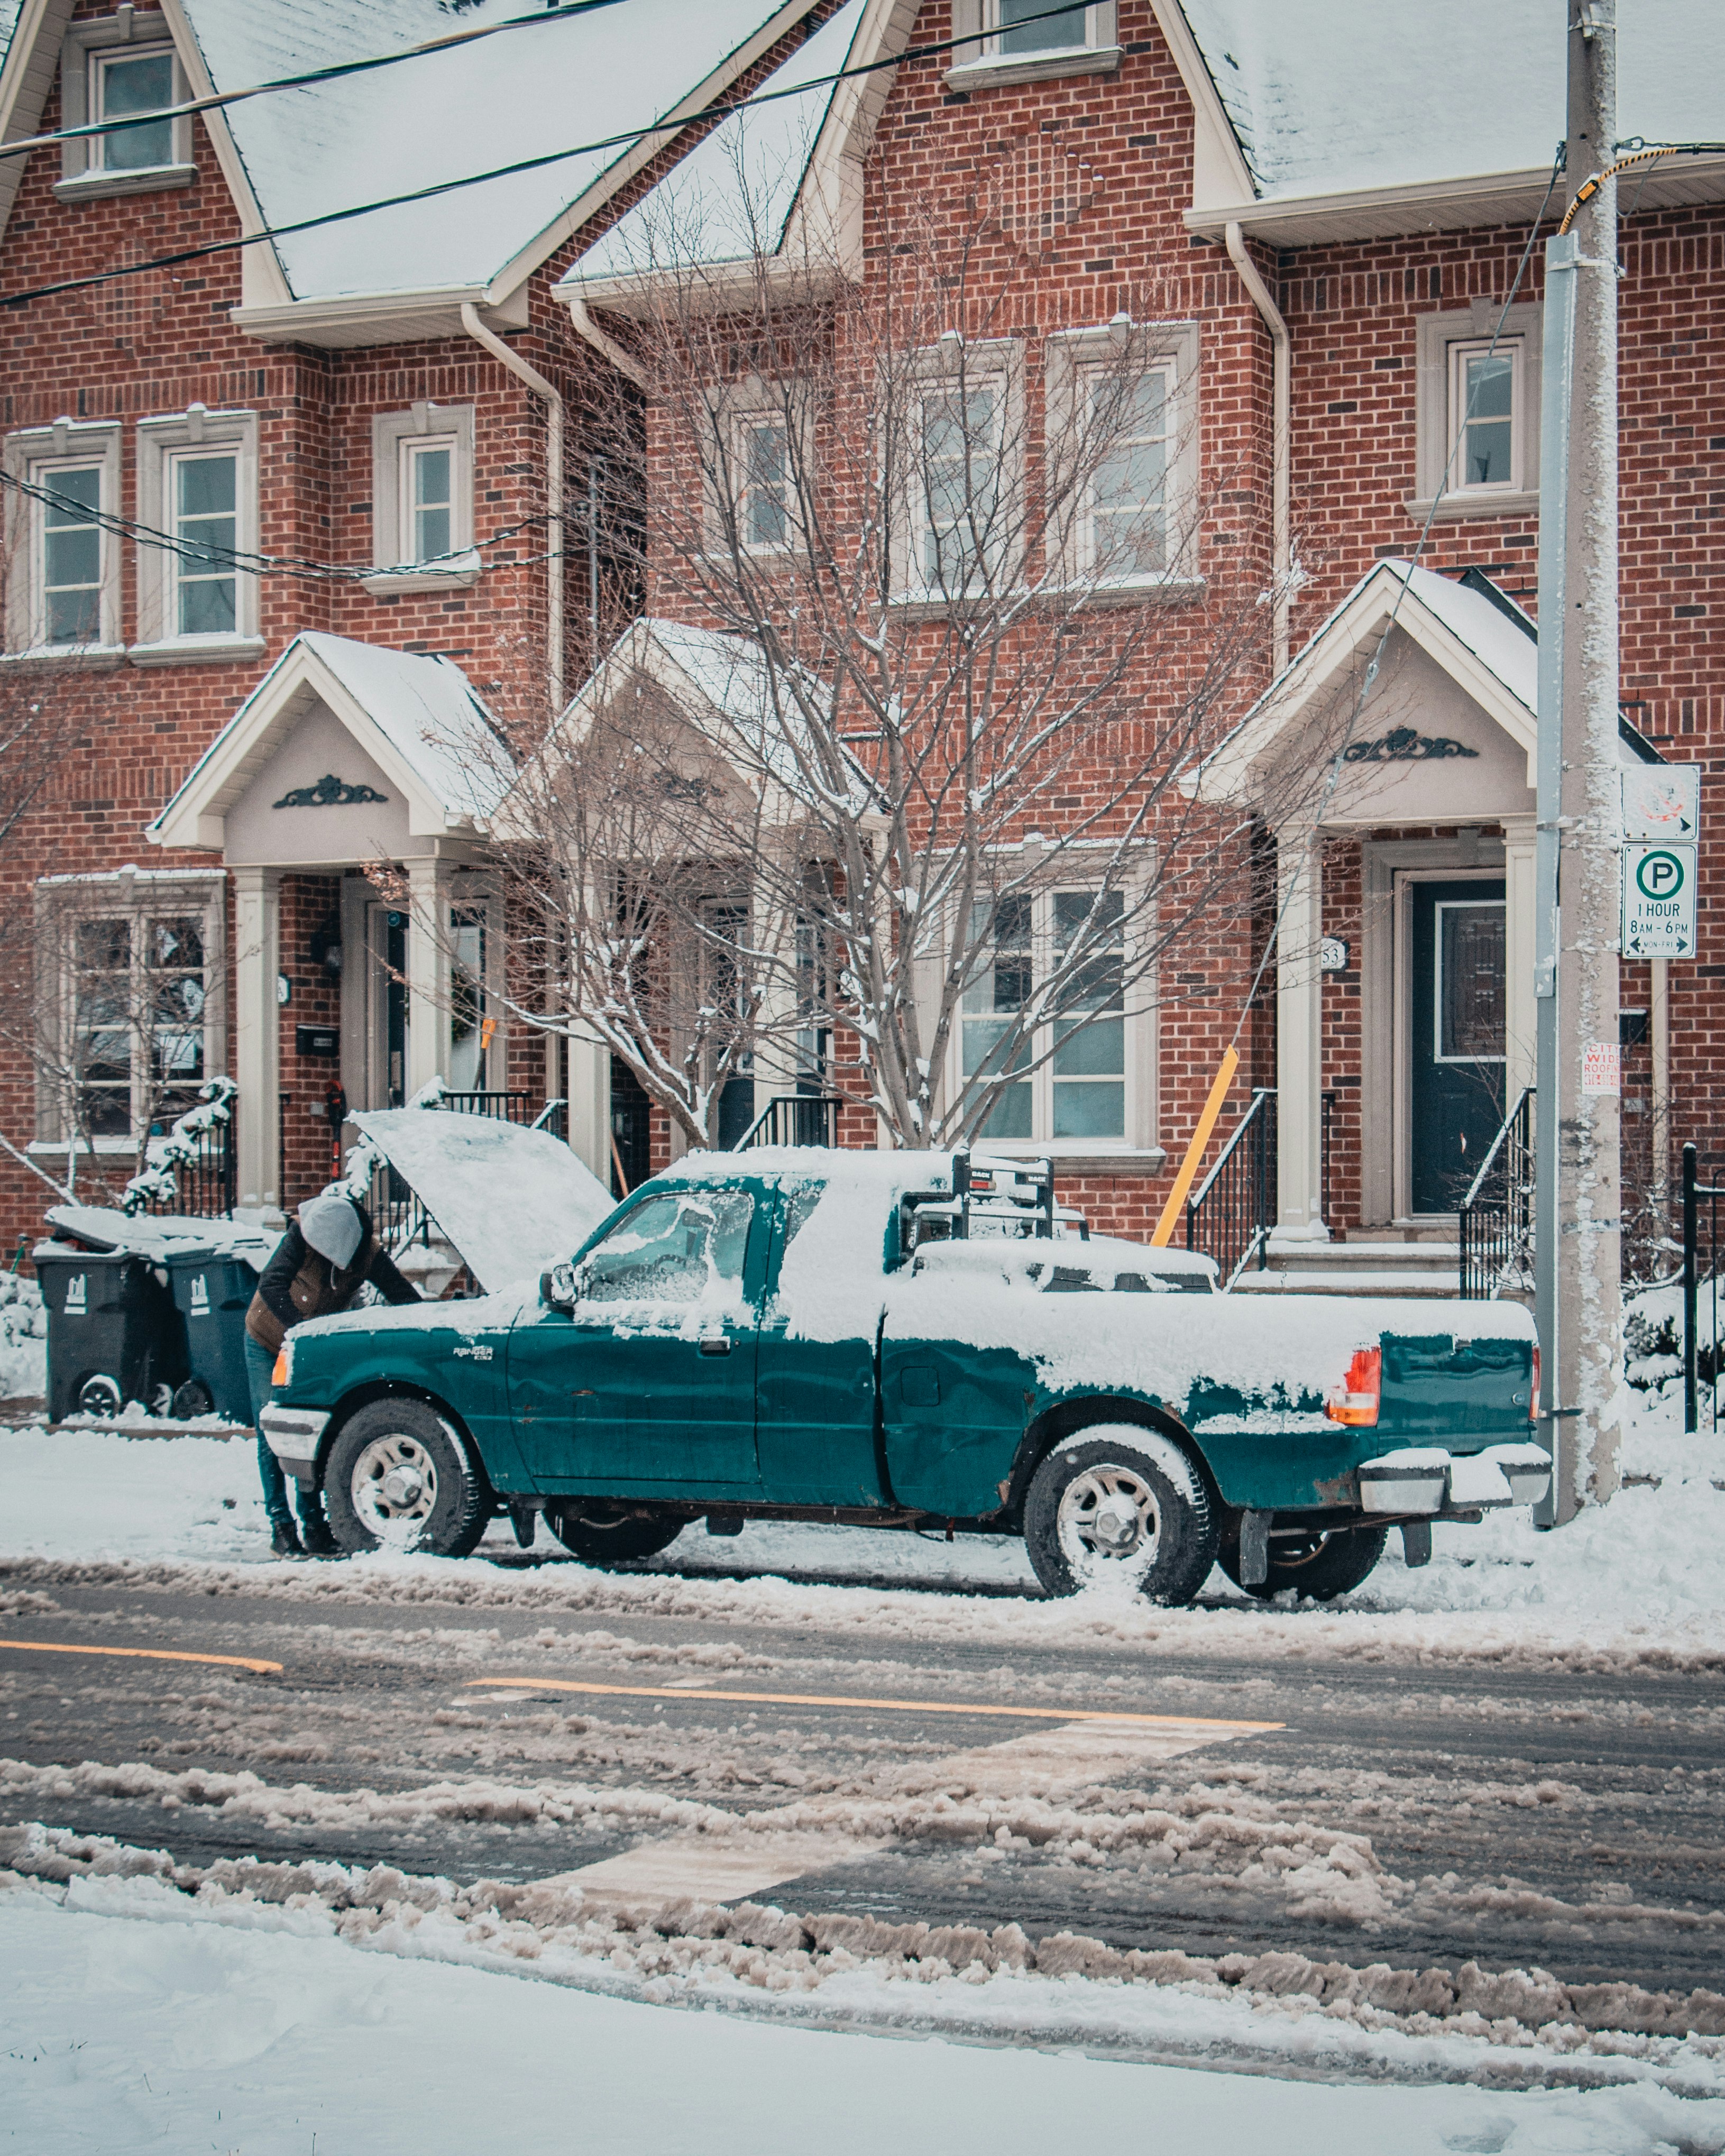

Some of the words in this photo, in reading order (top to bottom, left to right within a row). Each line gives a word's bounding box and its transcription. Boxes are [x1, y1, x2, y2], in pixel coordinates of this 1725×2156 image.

[1653, 863, 1673, 888] P
[1639, 904, 1641, 916] 1
[1647, 903, 1680, 916] HOUR
[1589, 1044, 1618, 1053] CITY
[1587, 1054, 1620, 1063] WIDE
[453, 1347, 493, 1356] RANGER
